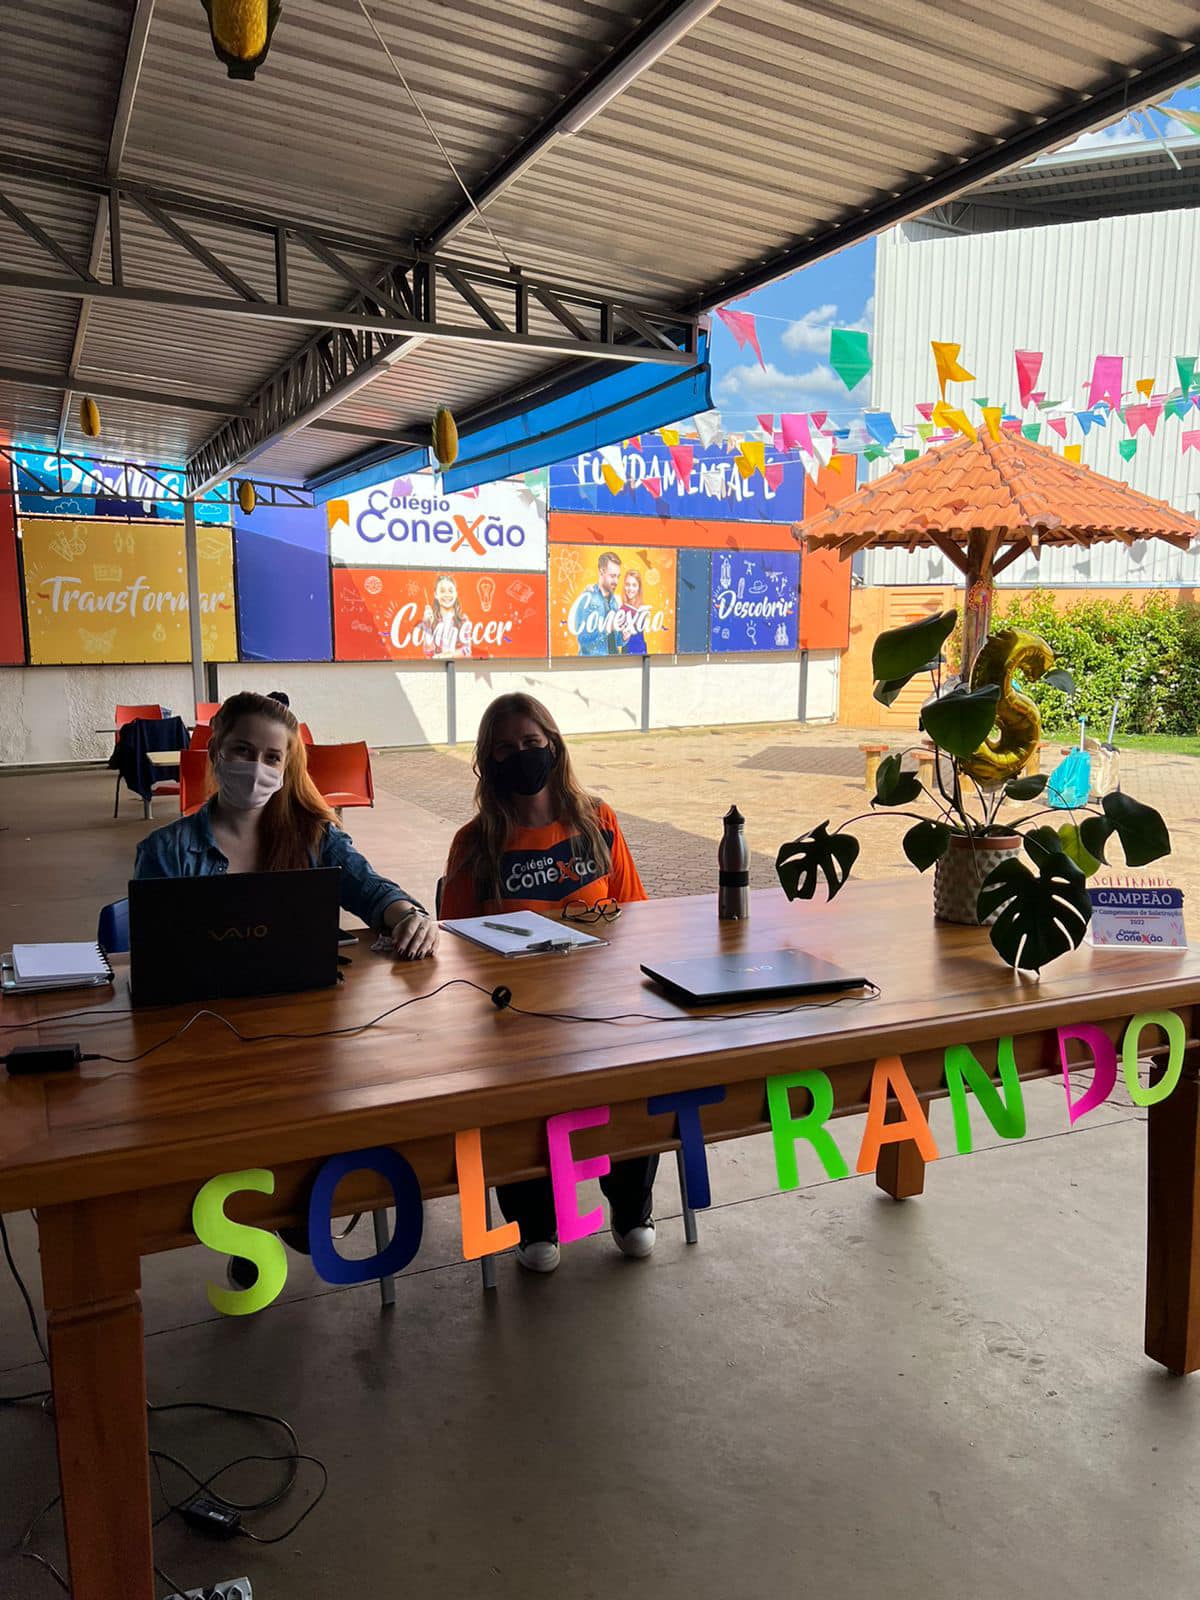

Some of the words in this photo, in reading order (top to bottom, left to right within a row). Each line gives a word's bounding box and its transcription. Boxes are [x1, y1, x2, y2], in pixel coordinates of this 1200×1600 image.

[367, 489, 450, 515] Colégio
[40, 576, 226, 617] Transformar
[717, 589, 794, 621] Descobrir
[389, 601, 513, 649] Conhecer
[511, 857, 554, 876] Colégio
[1098, 890, 1172, 905] CAMPEÃO
[208, 925, 268, 941] VAIO
[191, 1009, 1187, 1317] SOLETRANDO
